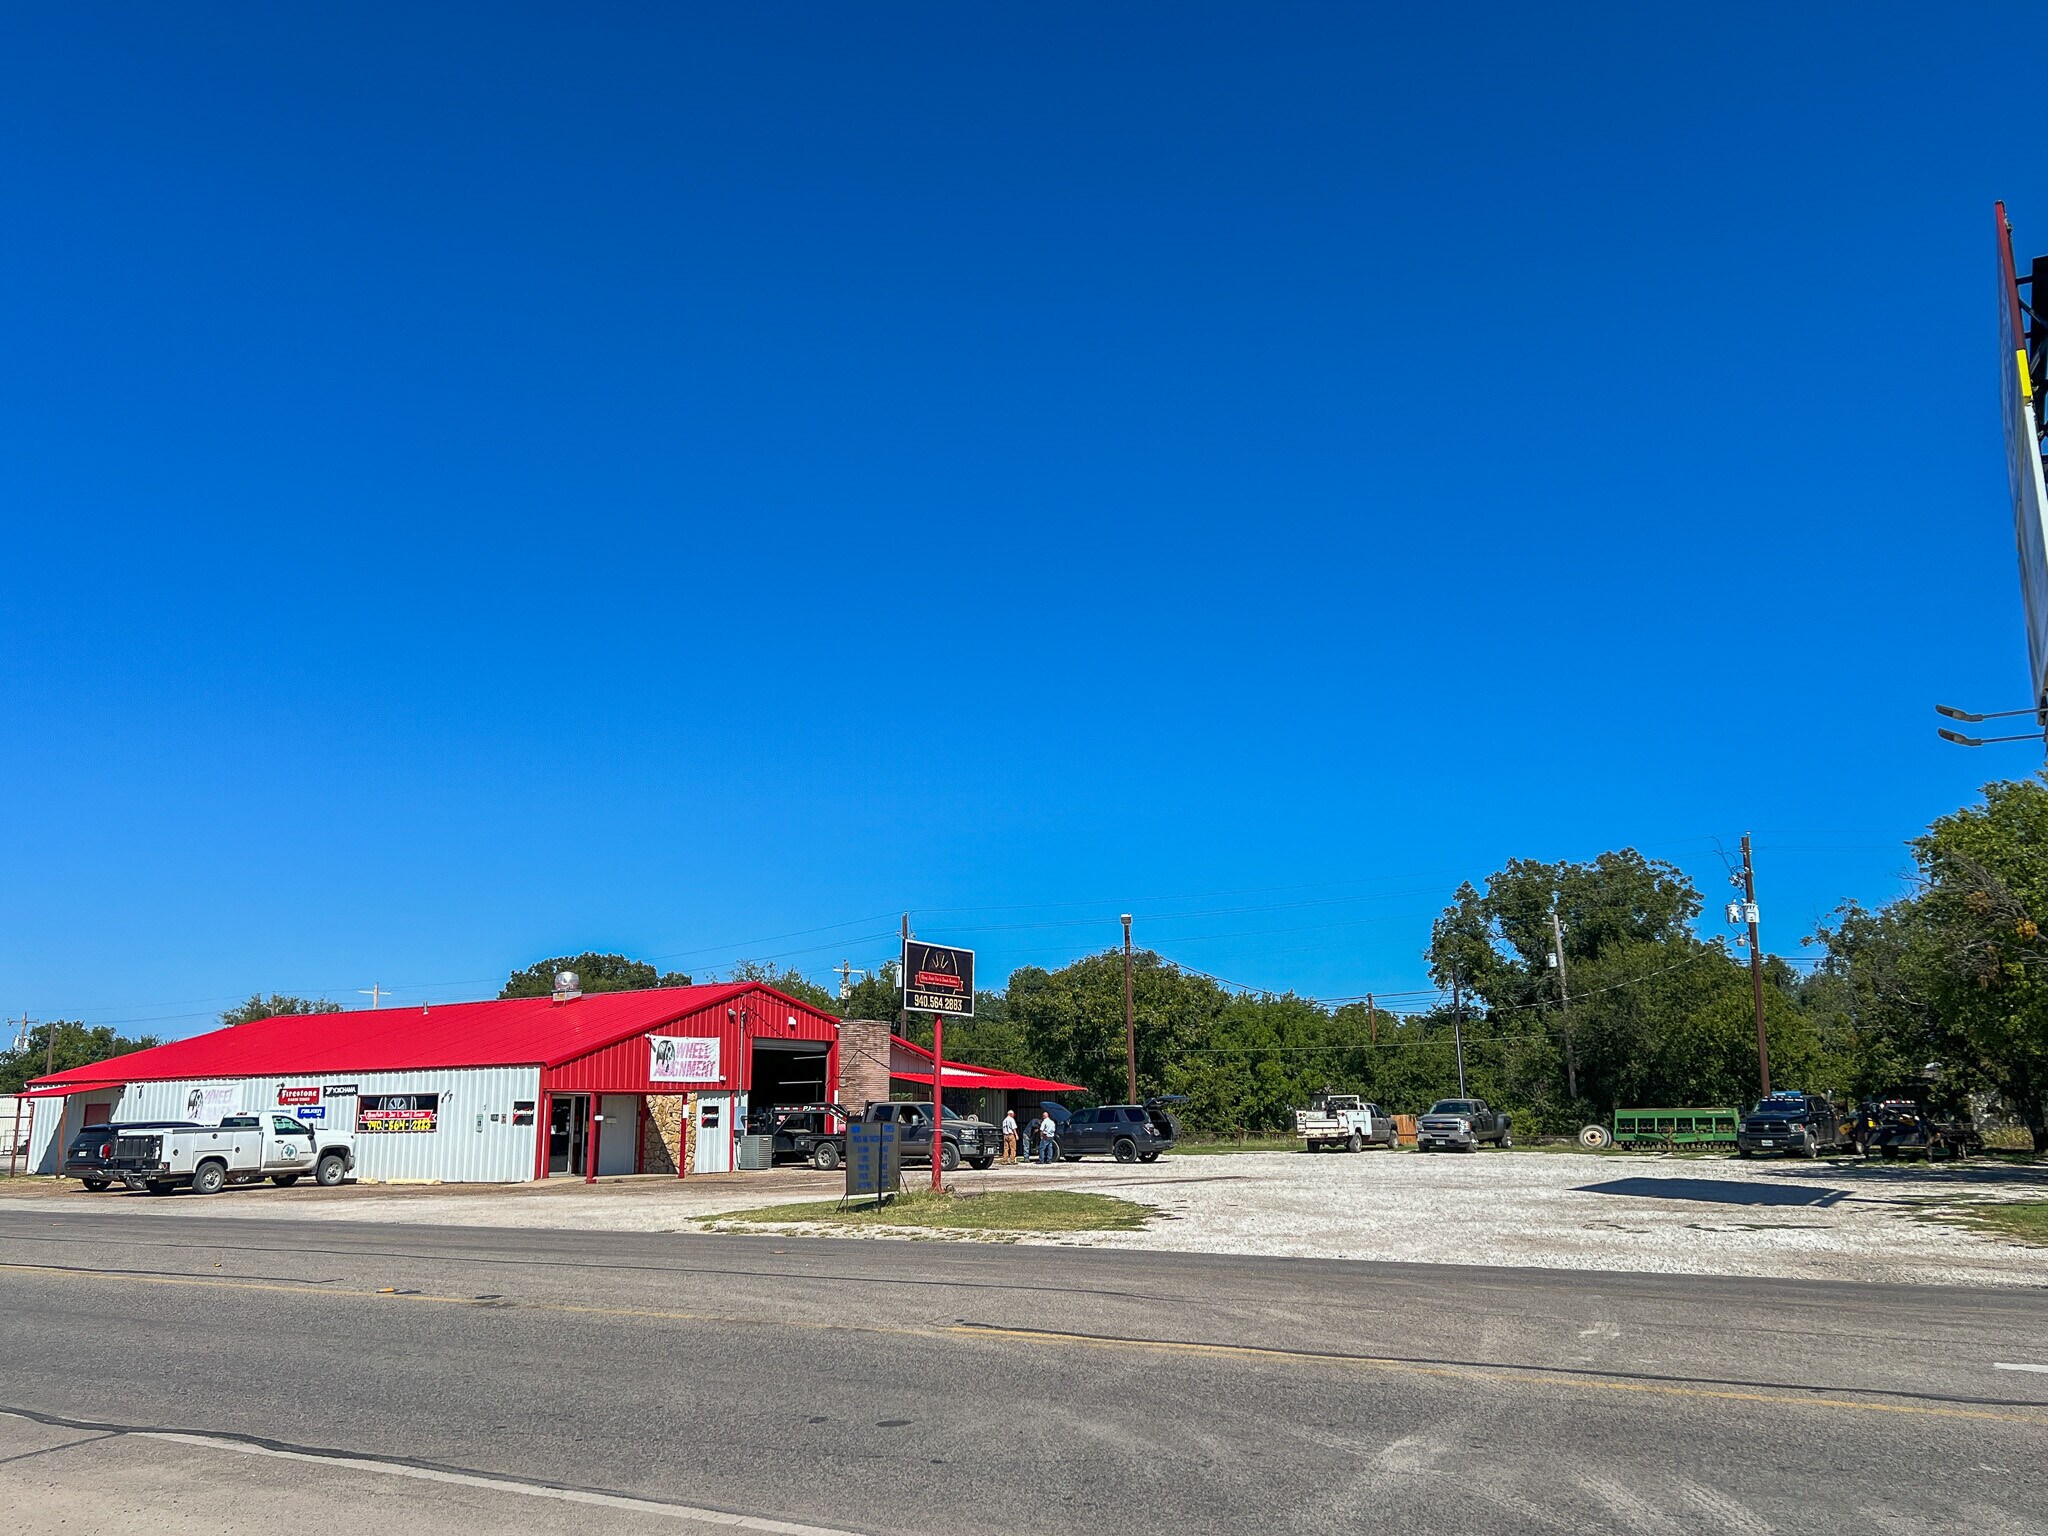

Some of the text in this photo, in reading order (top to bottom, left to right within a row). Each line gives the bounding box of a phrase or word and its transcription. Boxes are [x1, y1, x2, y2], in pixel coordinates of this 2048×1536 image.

[676, 1042, 710, 1059] WHEEL
[654, 1060, 716, 1077] ALIGNMENT
[281, 1090, 318, 1099] Firestone
